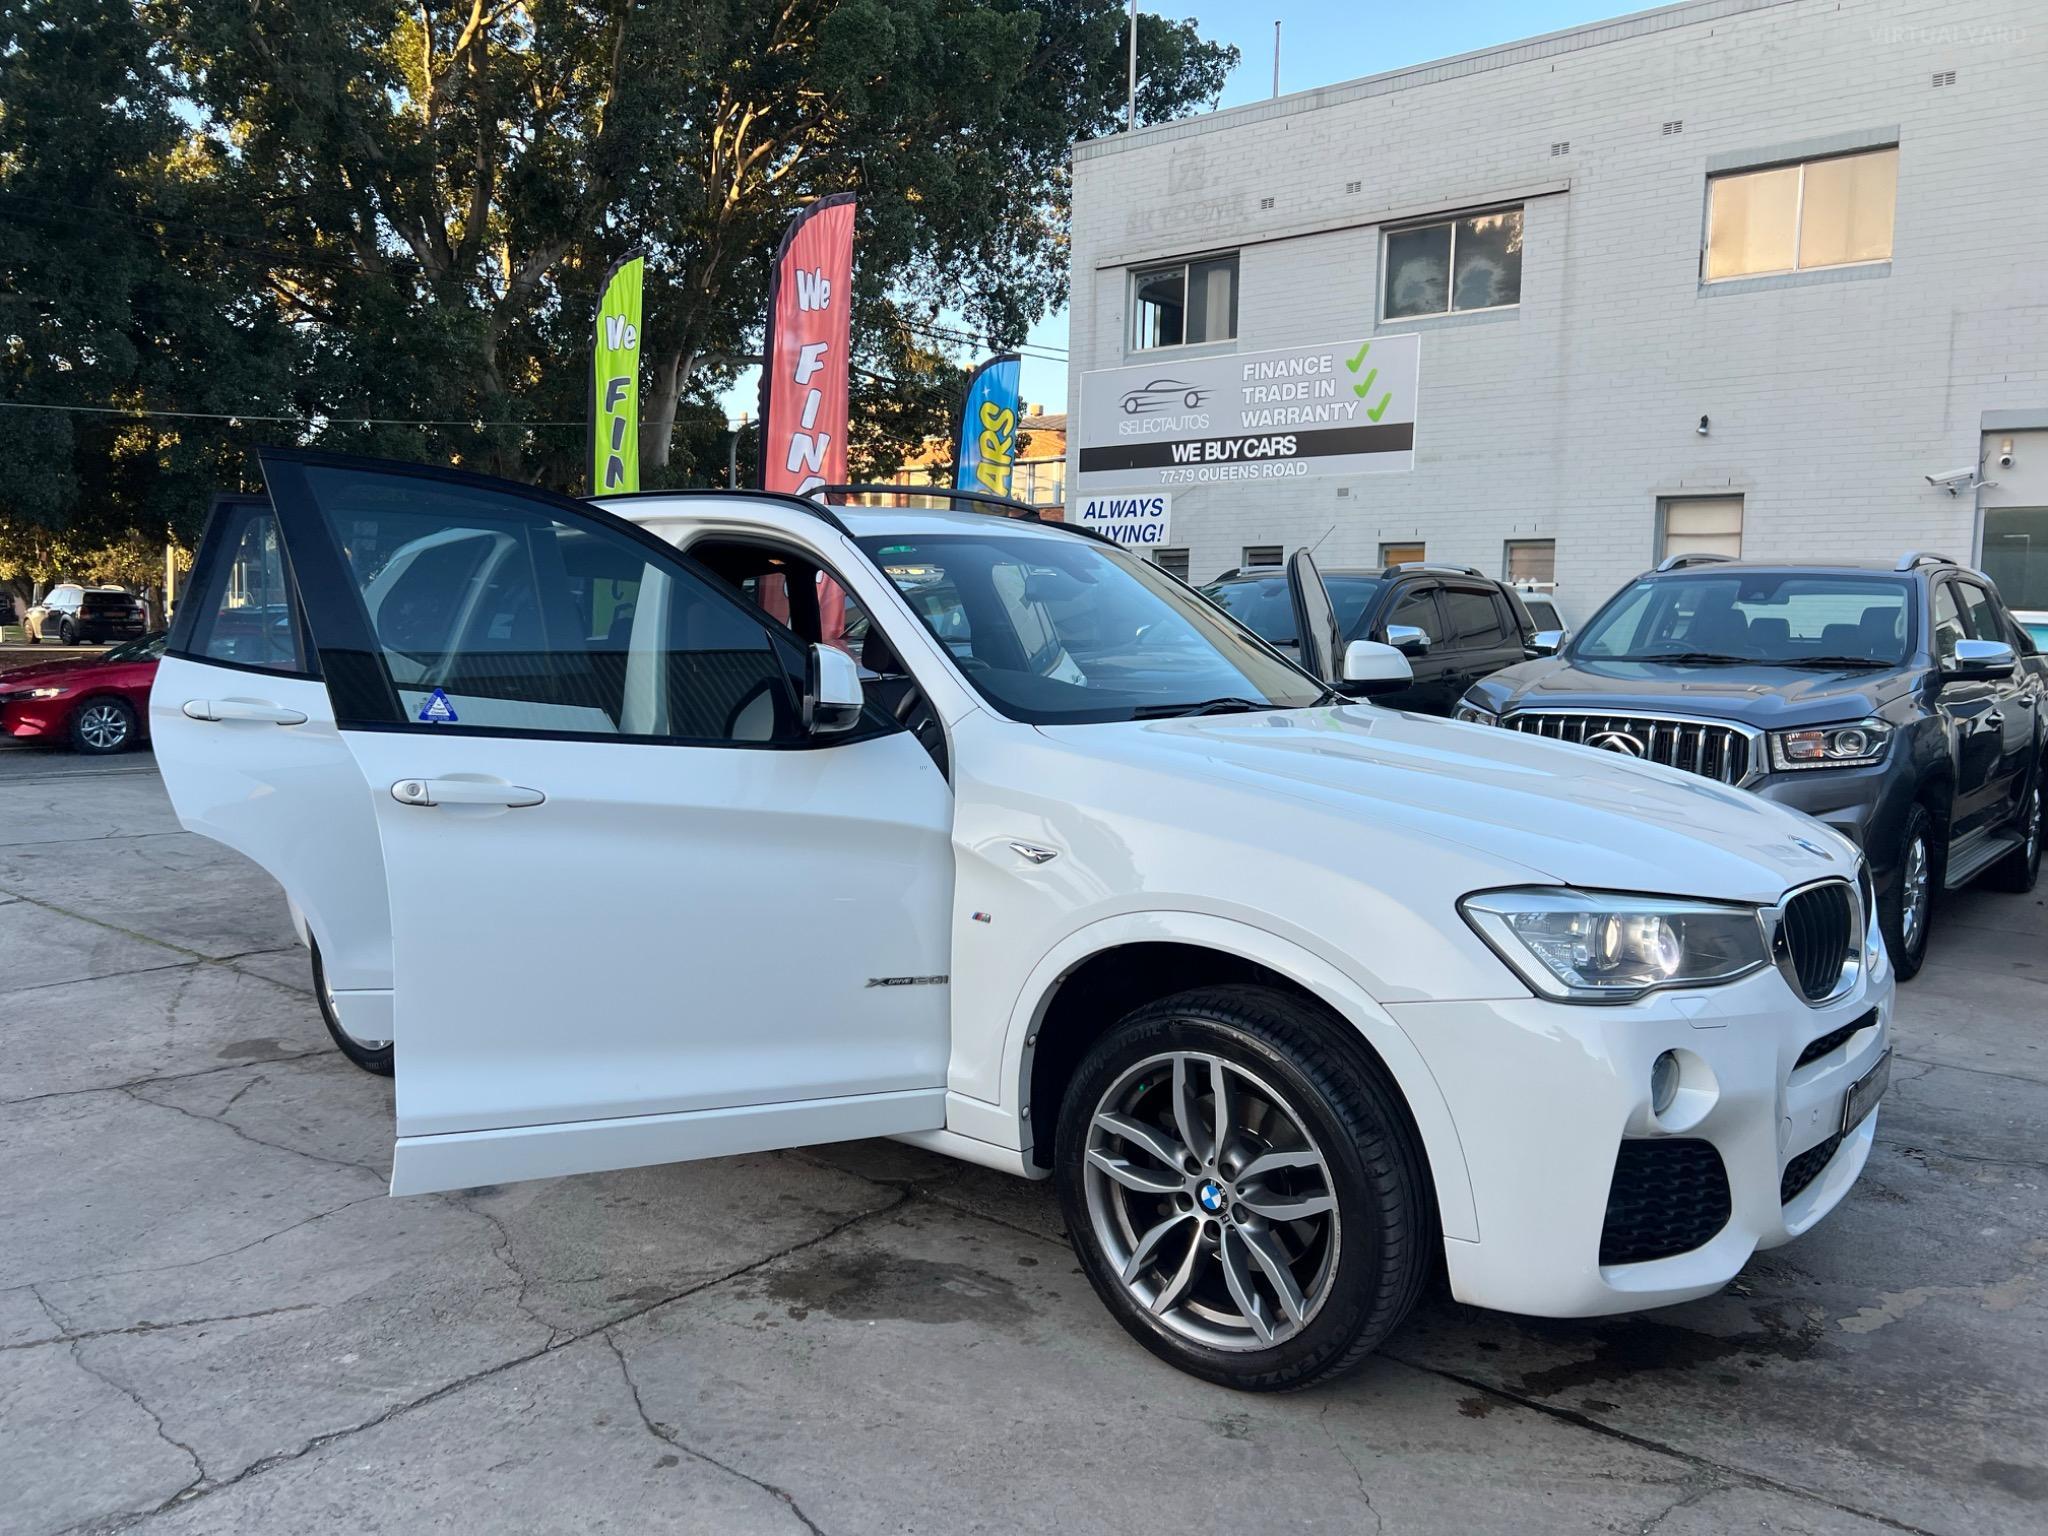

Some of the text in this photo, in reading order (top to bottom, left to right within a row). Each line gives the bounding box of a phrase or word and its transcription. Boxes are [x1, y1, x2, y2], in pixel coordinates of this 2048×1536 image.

[797, 268, 831, 312] We
[606, 314, 637, 351] We
[1242, 355, 1333, 380] FINANCE
[1242, 379, 1336, 404] TRADE IN
[1241, 401, 1359, 428] WARRANTY
[1171, 435, 1297, 463] WE BUY CARS
[1160, 461, 1308, 483] 77-79 QUEENS ROAD
[1084, 498, 1163, 519] ALWAYS
